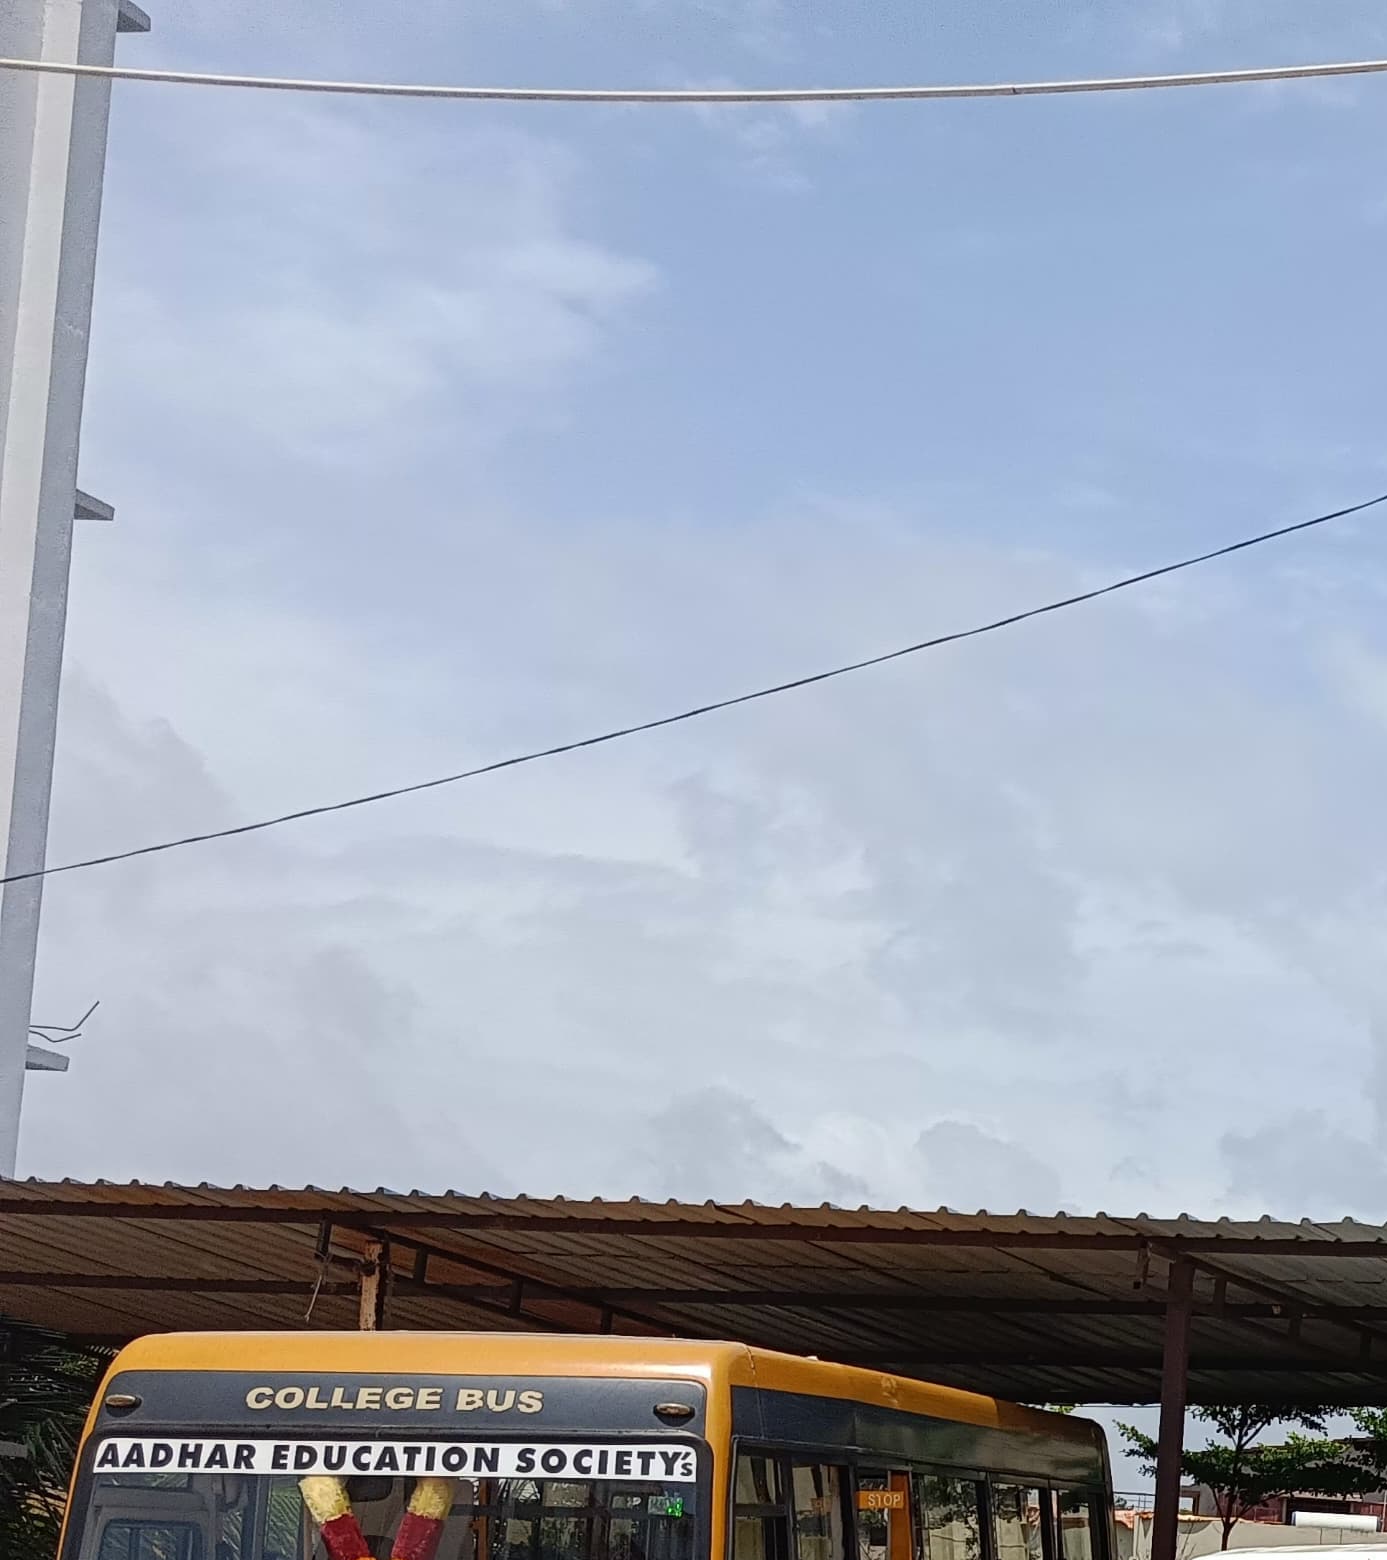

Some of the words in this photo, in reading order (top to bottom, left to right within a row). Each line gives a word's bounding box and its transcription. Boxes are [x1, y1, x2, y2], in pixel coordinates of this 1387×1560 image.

[245, 1386, 444, 1411] COLLEGE
[455, 1388, 544, 1413] BUS
[96, 1442, 255, 1469] AADHAR
[271, 1445, 500, 1473] EDUCATION
[867, 1493, 901, 1507] STOP
